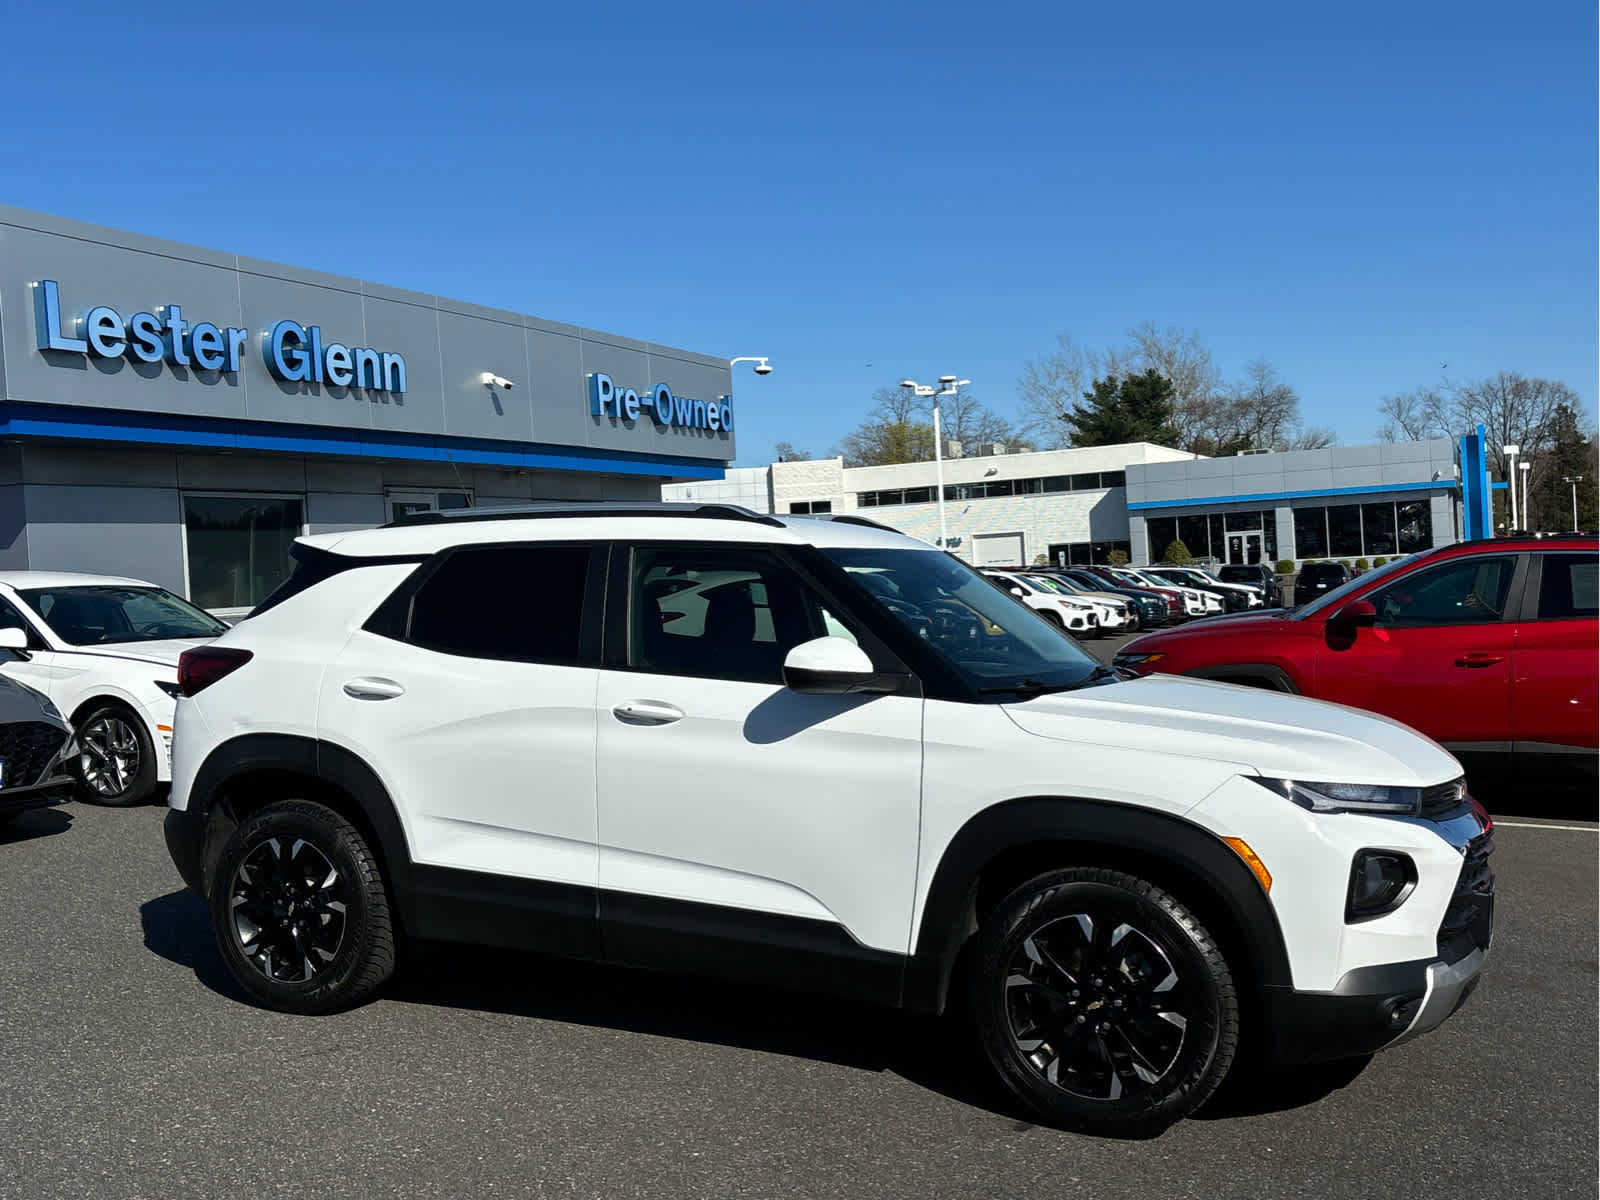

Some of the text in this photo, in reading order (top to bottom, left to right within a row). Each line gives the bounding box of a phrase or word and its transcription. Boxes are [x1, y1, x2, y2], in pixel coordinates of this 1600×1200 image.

[32, 279, 408, 394] Lester Glenn
[589, 372, 733, 432] Pre-Owned
